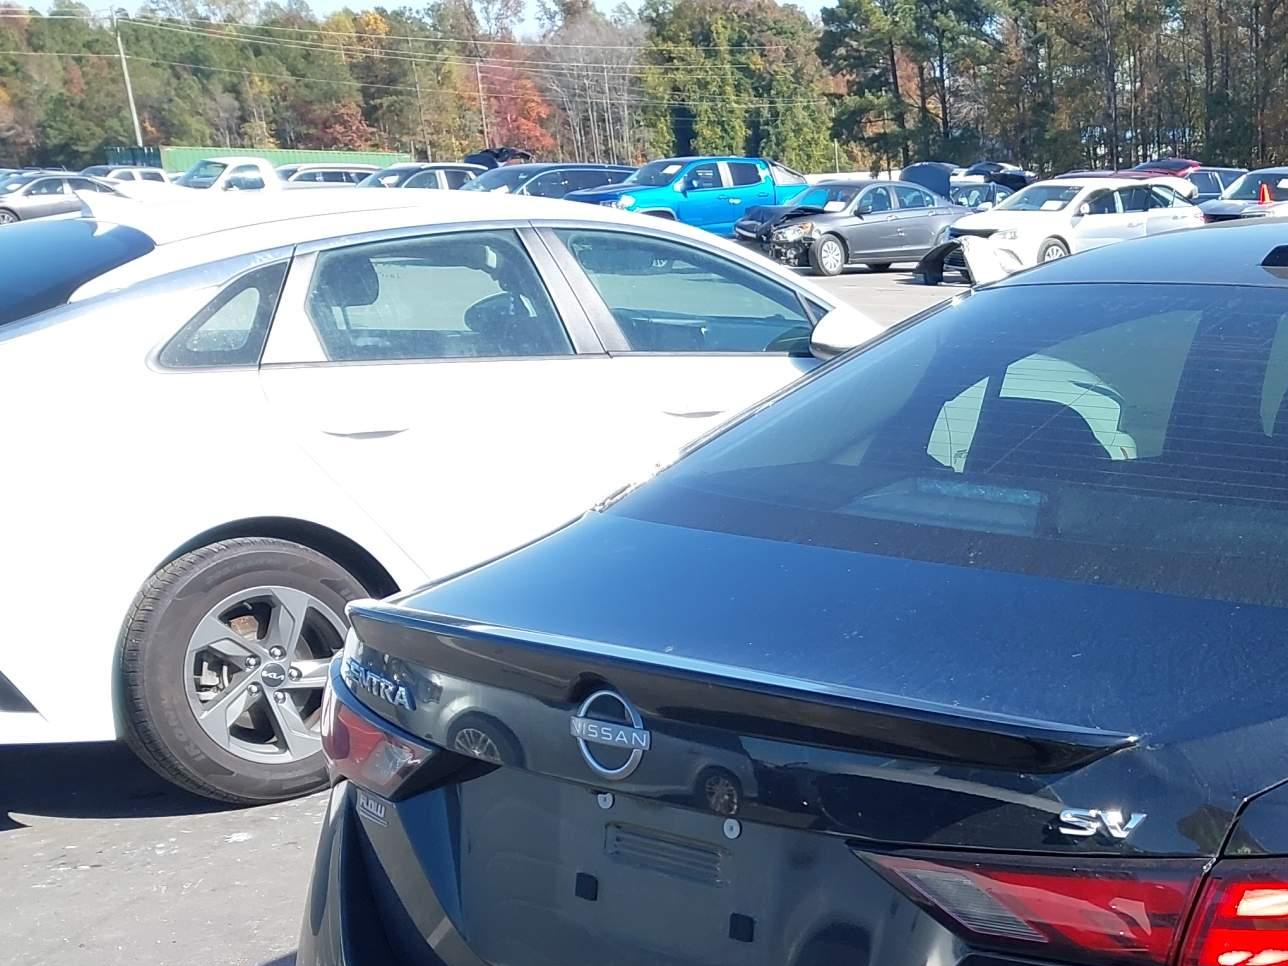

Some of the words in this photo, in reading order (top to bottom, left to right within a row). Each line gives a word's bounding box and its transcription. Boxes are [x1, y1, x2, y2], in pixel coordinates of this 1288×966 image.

[571, 719, 647, 747] NISSAN
[359, 793, 386, 819] FLOW
[1058, 807, 1148, 838] SV
